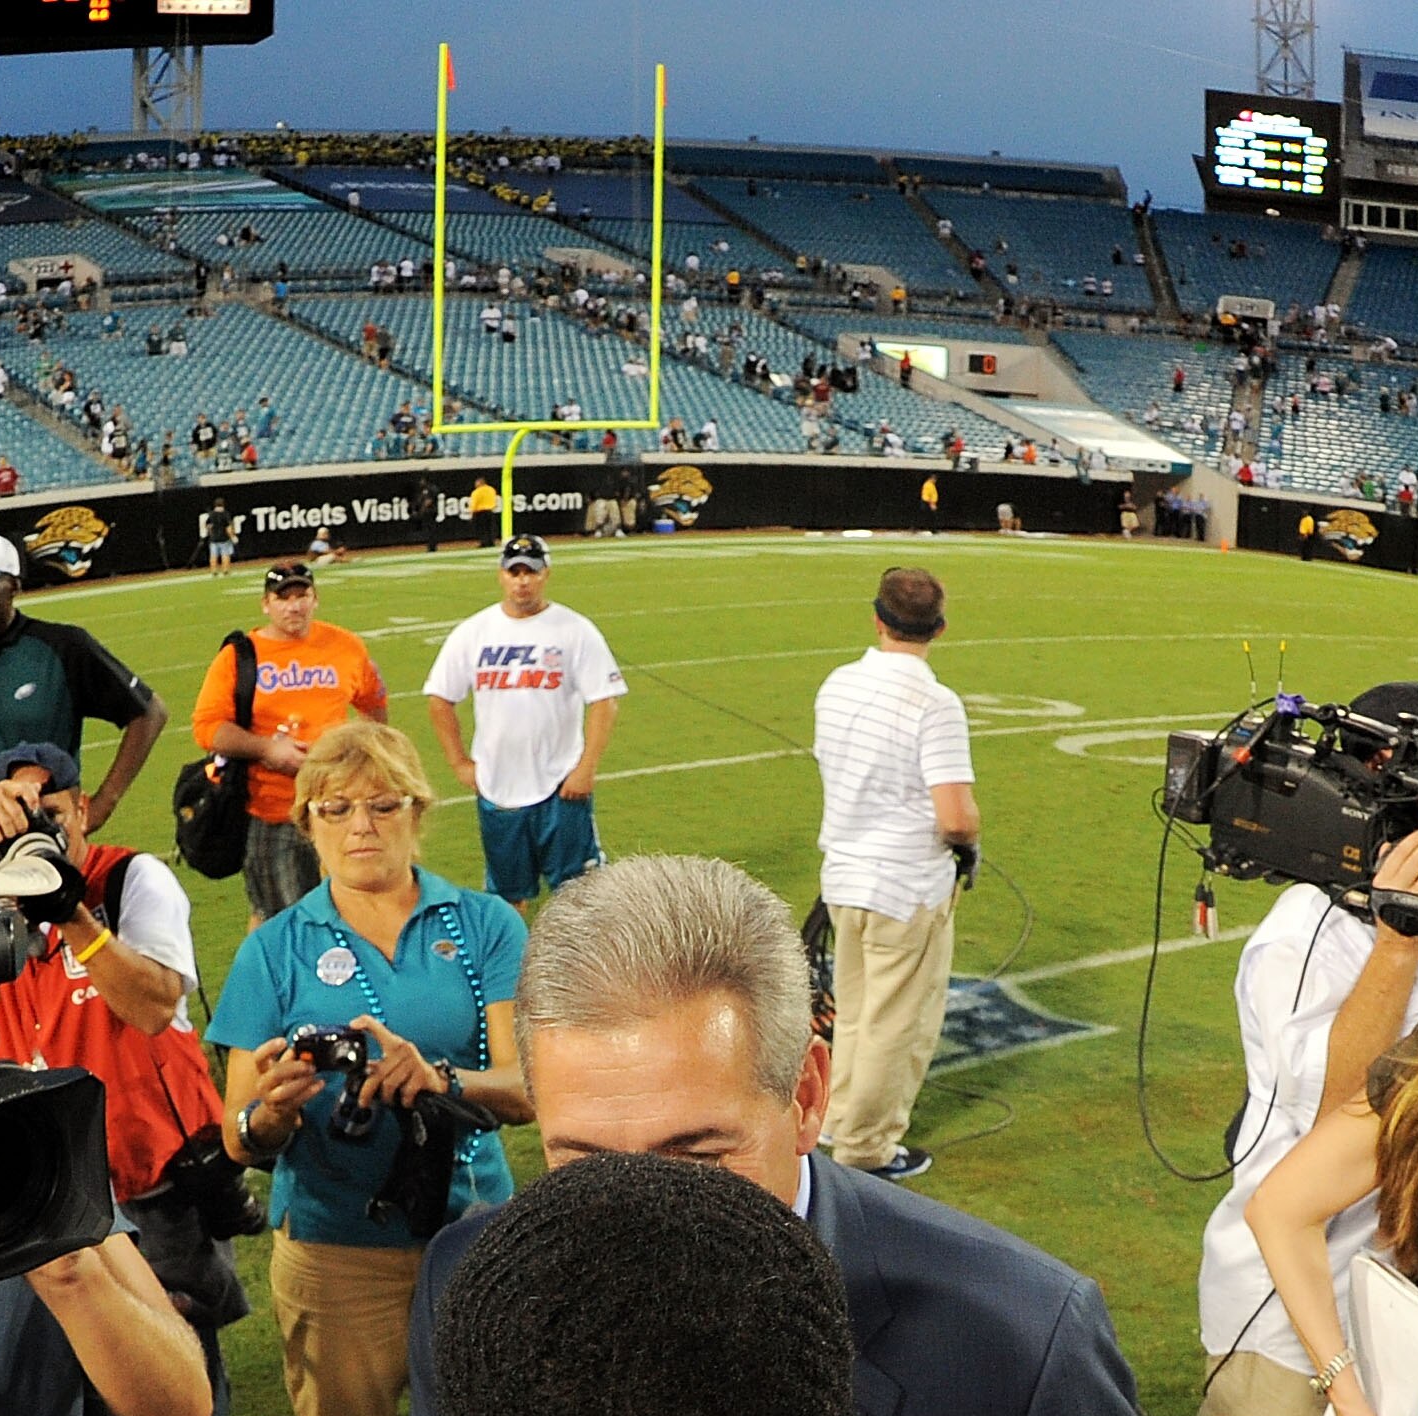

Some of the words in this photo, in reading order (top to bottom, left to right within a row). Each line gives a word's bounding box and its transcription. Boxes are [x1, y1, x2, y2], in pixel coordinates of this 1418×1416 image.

[251, 502, 346, 532] Tickets
[352, 497, 409, 525] Visit
[476, 645, 537, 668] NFL
[256, 658, 339, 694] Gators
[474, 670, 563, 691] FILMS
